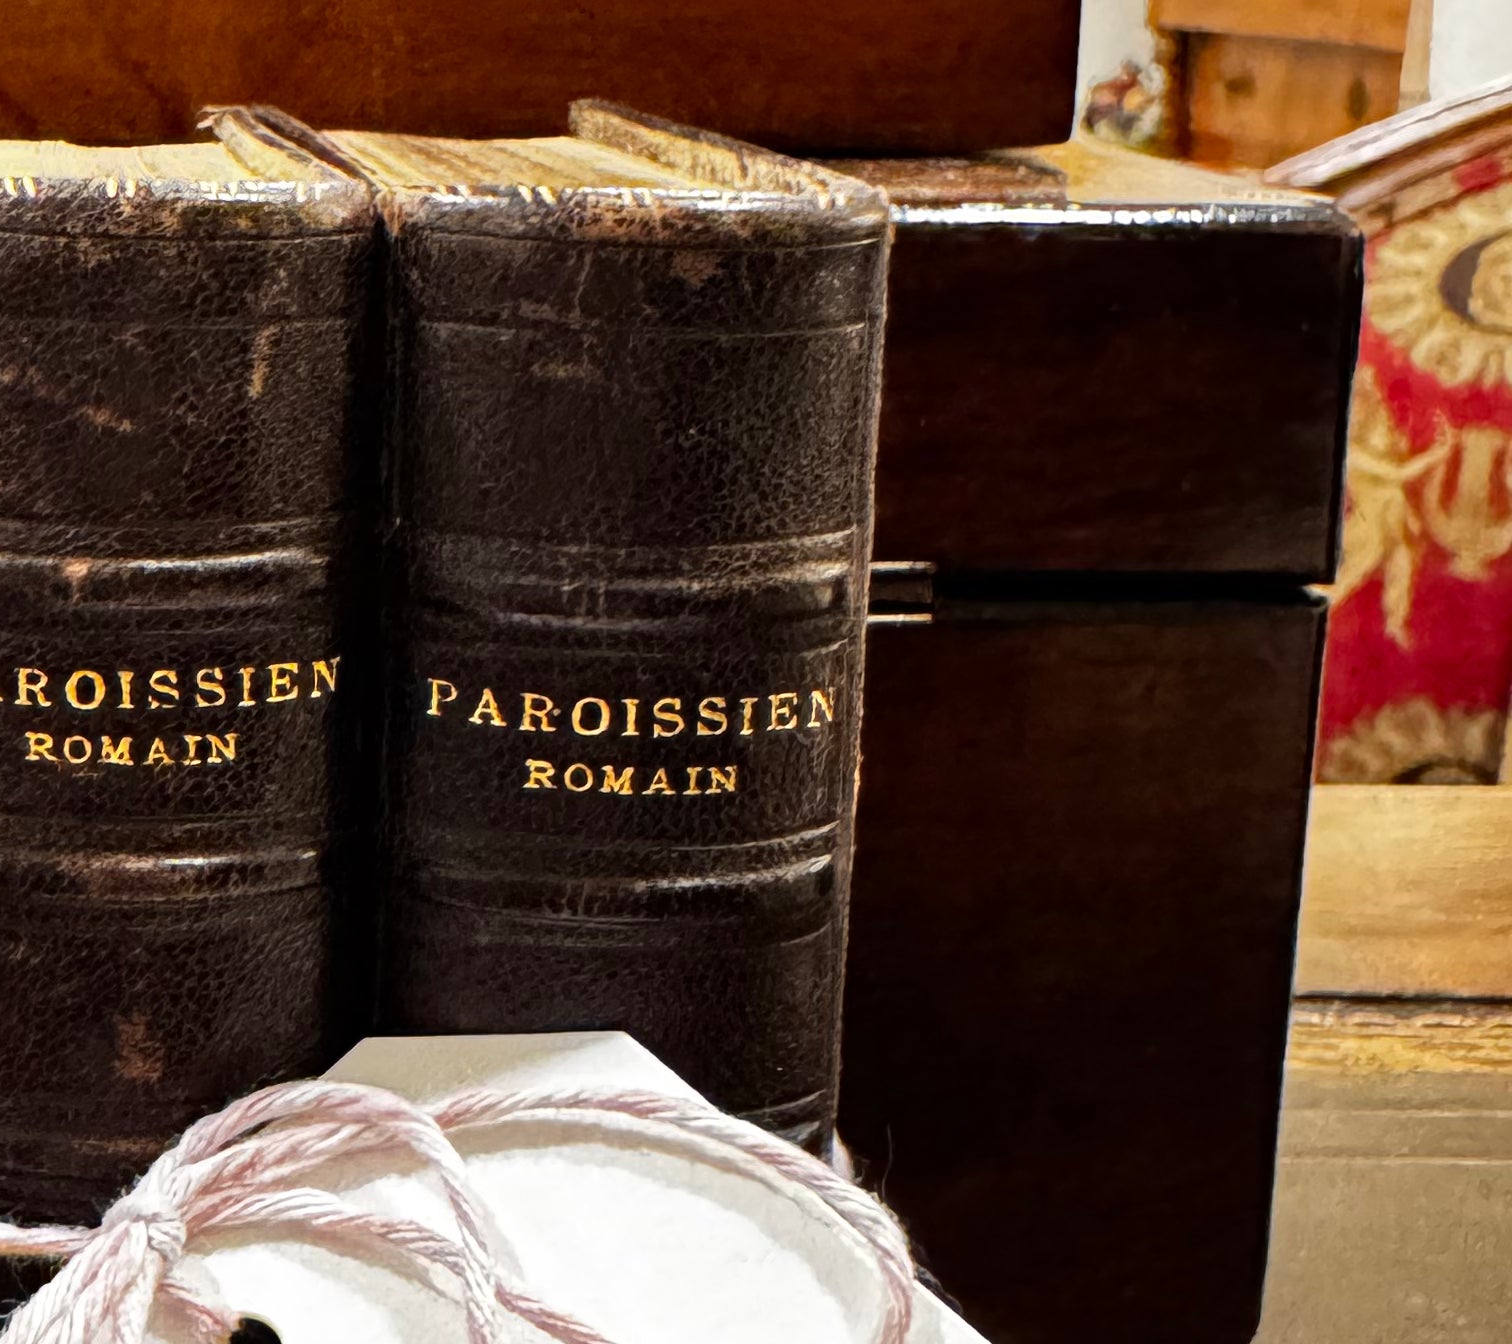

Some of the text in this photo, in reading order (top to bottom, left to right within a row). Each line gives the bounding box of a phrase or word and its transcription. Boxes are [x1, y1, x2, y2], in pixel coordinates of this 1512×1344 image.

[426, 678, 836, 738] PAROISSIEN
[24, 730, 241, 768] ROMAIN
[522, 758, 738, 795] ROMAIN
